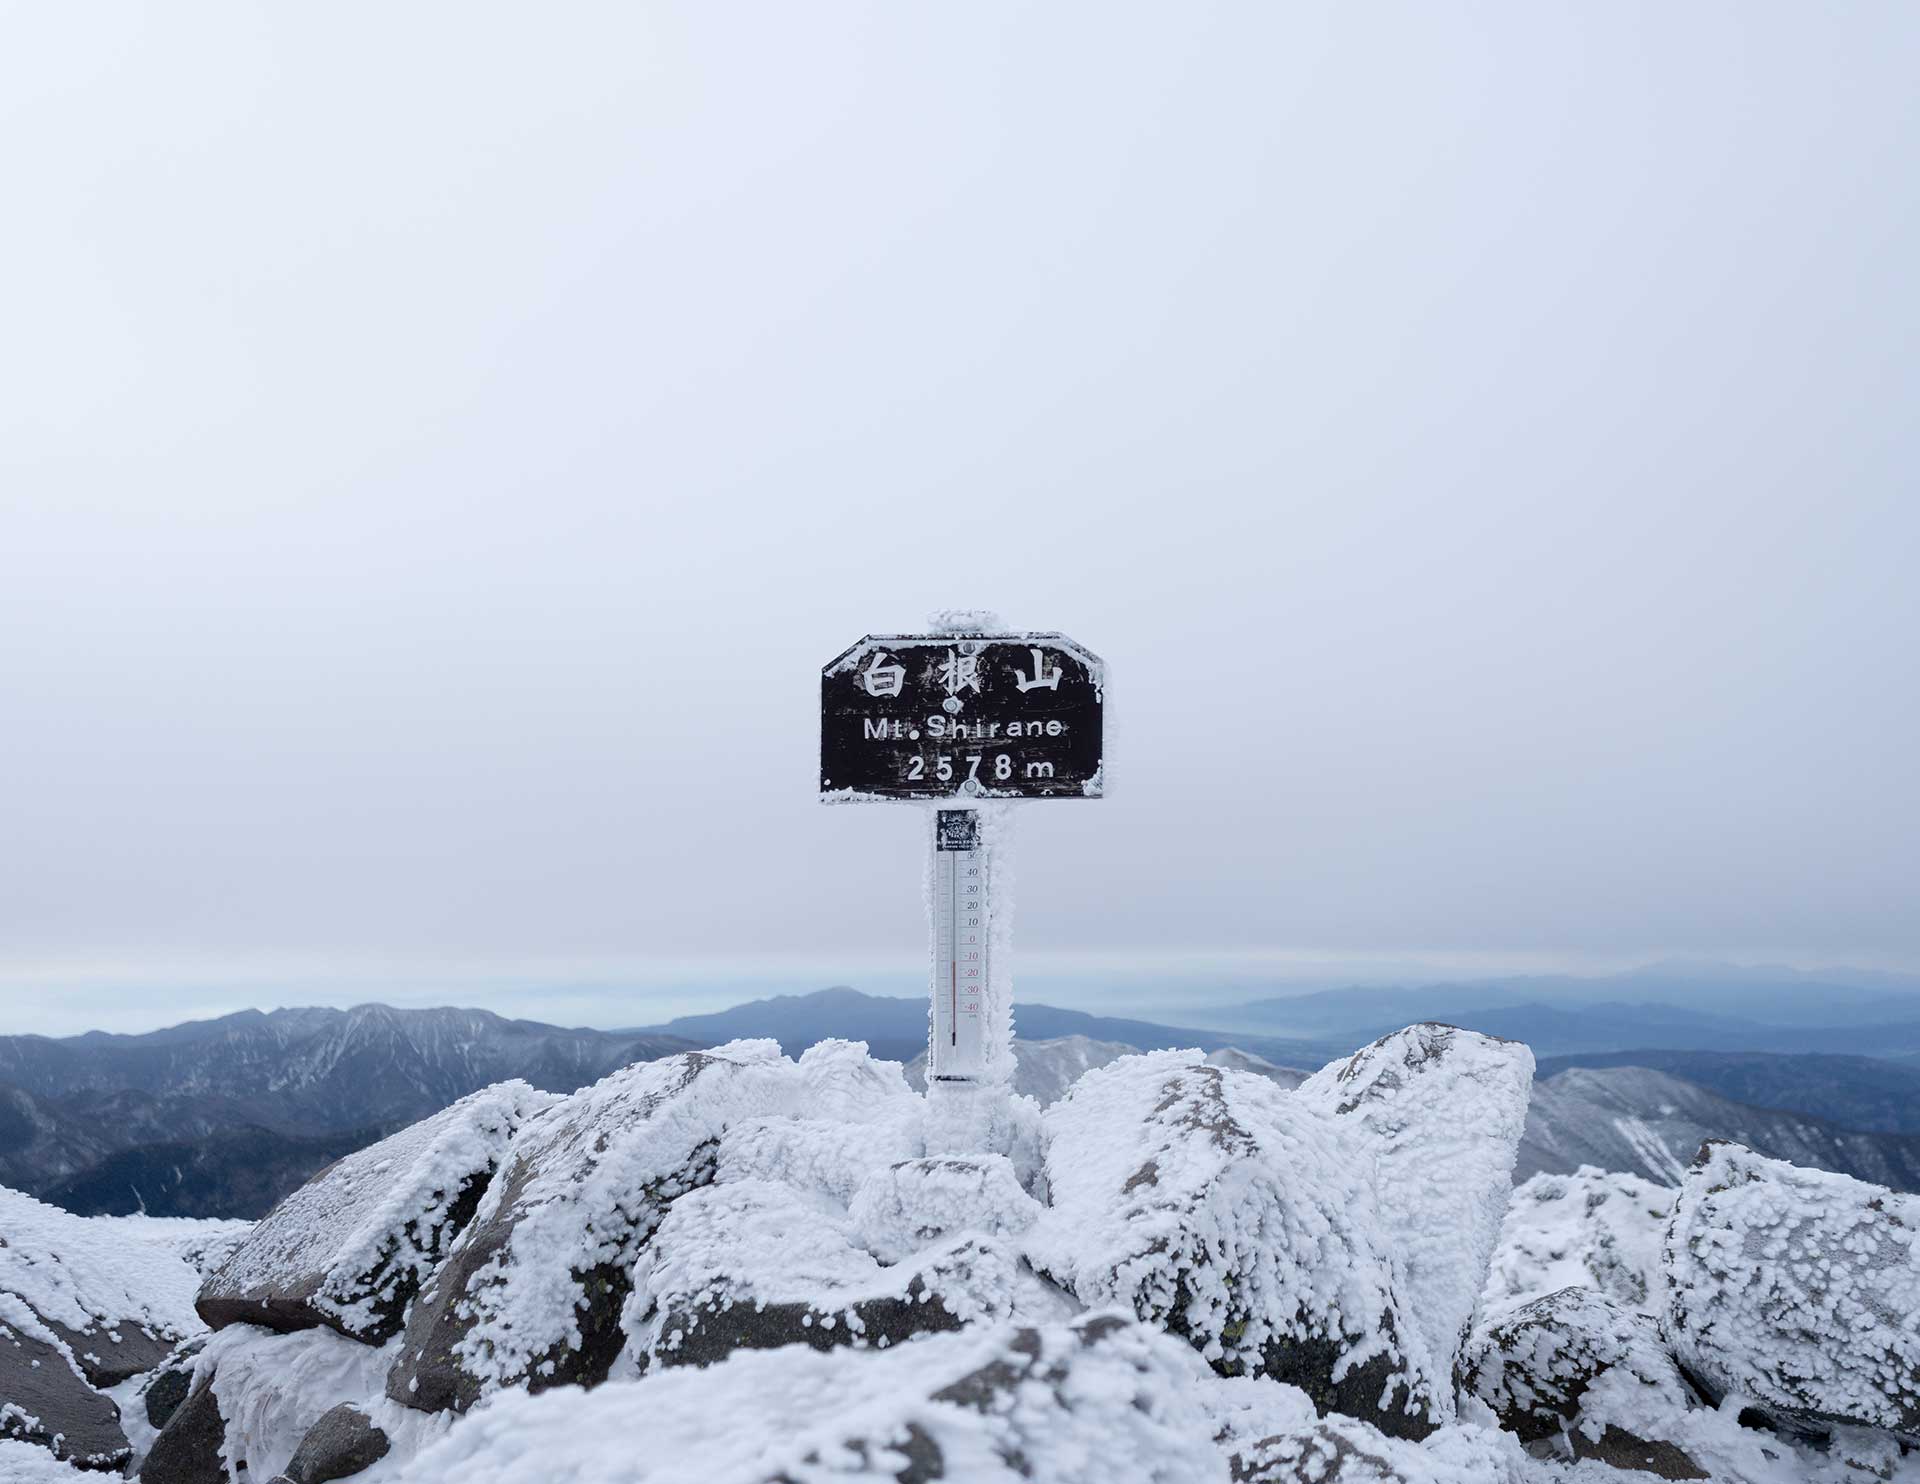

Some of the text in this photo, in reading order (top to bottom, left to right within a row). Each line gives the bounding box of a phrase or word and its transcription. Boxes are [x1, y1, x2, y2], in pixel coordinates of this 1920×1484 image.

[862, 648, 1063, 698] 白根山
[967, 868, 978, 876] 40
[967, 885, 978, 893] 30
[967, 901, 978, 910] 20
[968, 918, 978, 926] 10
[969, 935, 976, 943] 0
[964, 952, 978, 960] -10
[964, 968, 978, 977] -20
[964, 985, 979, 994] -30
[964, 1002, 978, 1011] -40
